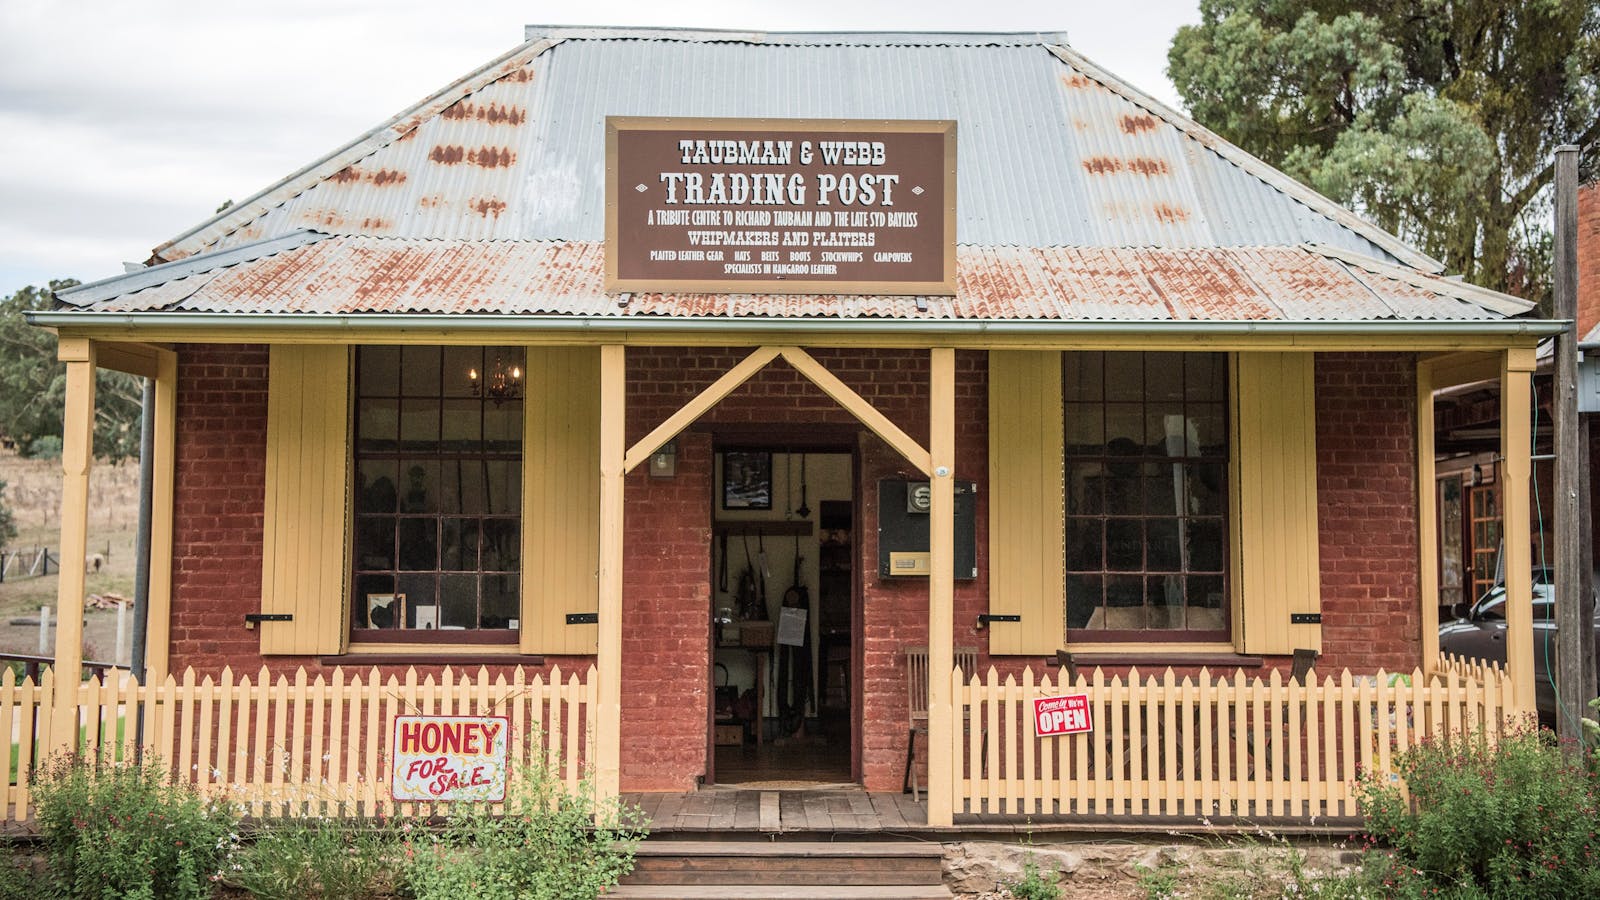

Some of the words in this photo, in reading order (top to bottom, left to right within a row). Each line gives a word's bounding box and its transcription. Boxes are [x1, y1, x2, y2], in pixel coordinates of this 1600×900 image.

[679, 139, 793, 165] TAUBMAN
[800, 141, 814, 165] &
[819, 141, 886, 166] WEBB
[660, 172, 807, 205] TRADING
[817, 174, 899, 206] POST
[648, 210, 654, 225] A
[656, 210, 689, 225] TRIBUTE
[692, 210, 720, 226] CENTRE
[723, 211, 733, 226] TO
[735, 211, 771, 226] RICHARD
[774, 211, 812, 227] TAUBMAN
[815, 212, 832, 227] AND
[834, 212, 848, 227] THE
[851, 212, 868, 227] LATE
[870, 212, 885, 227] SYD
[888, 212, 918, 227] BAYLISS
[688, 231, 778, 245] WHIPMAKERS
[782, 232, 809, 246] AND
[813, 232, 875, 246] PLAITERS
[651, 251, 676, 260] PLAITED
[678, 251, 704, 260] LEATHER
[706, 251, 724, 261] GEAR
[735, 251, 750, 261] HATS
[762, 251, 779, 261] BELTS
[790, 252, 811, 262] BOOTS
[821, 252, 863, 262] STOCKWHIPS
[874, 252, 912, 262] CAMPOVENS
[724, 264, 762, 273] SPECIALISTS
[764, 264, 770, 273] IN
[772, 264, 809, 274] KANGAROO
[811, 265, 837, 274] LEATHER
[1039, 701, 1059, 712] Come
[1059, 700, 1067, 709] in
[1068, 699, 1083, 708] We're
[1039, 709, 1086, 732] OPEN
[401, 722, 501, 755] HONEY
[407, 757, 453, 780] FOR
[429, 766, 490, 795] SALE
